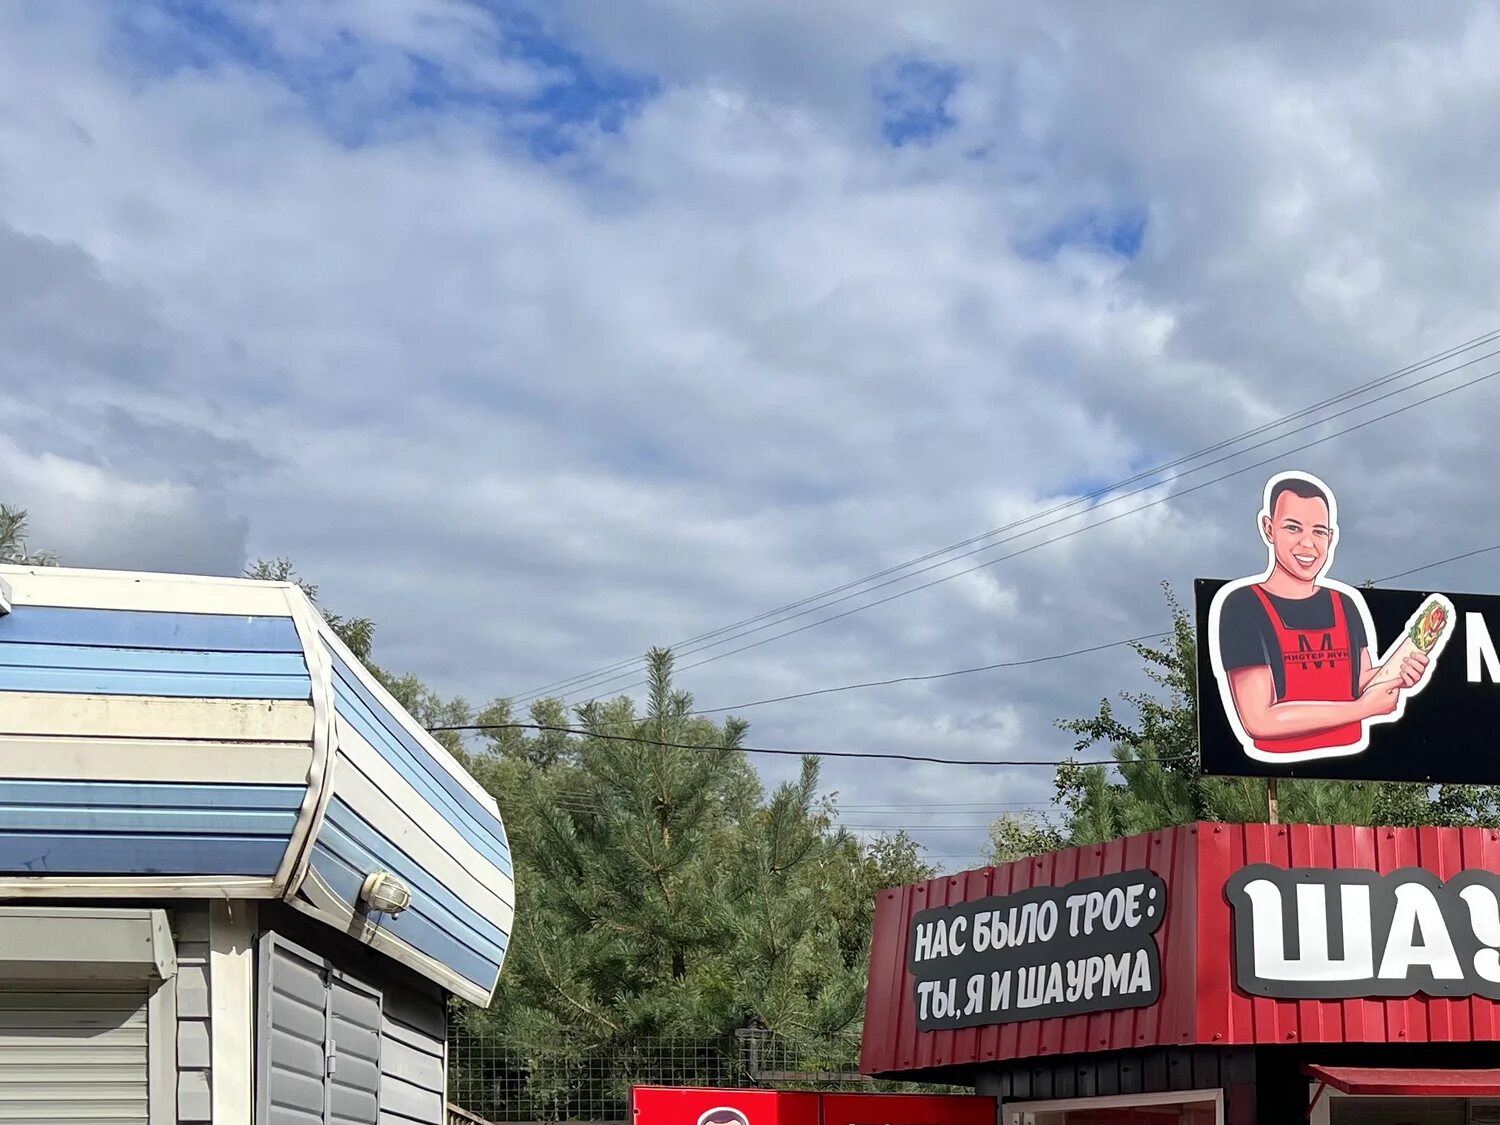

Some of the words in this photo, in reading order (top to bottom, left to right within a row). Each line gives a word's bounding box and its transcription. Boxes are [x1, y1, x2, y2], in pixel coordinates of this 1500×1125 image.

[914, 916, 968, 962] НАС
[972, 900, 1058, 953] БЫЛО
[1066, 884, 1156, 938] ТРОЕ:
[917, 977, 961, 1020] ТЫ,
[964, 974, 985, 1016] Я
[990, 970, 1011, 1011] И
[1016, 949, 1152, 1008] ШАУРМА
